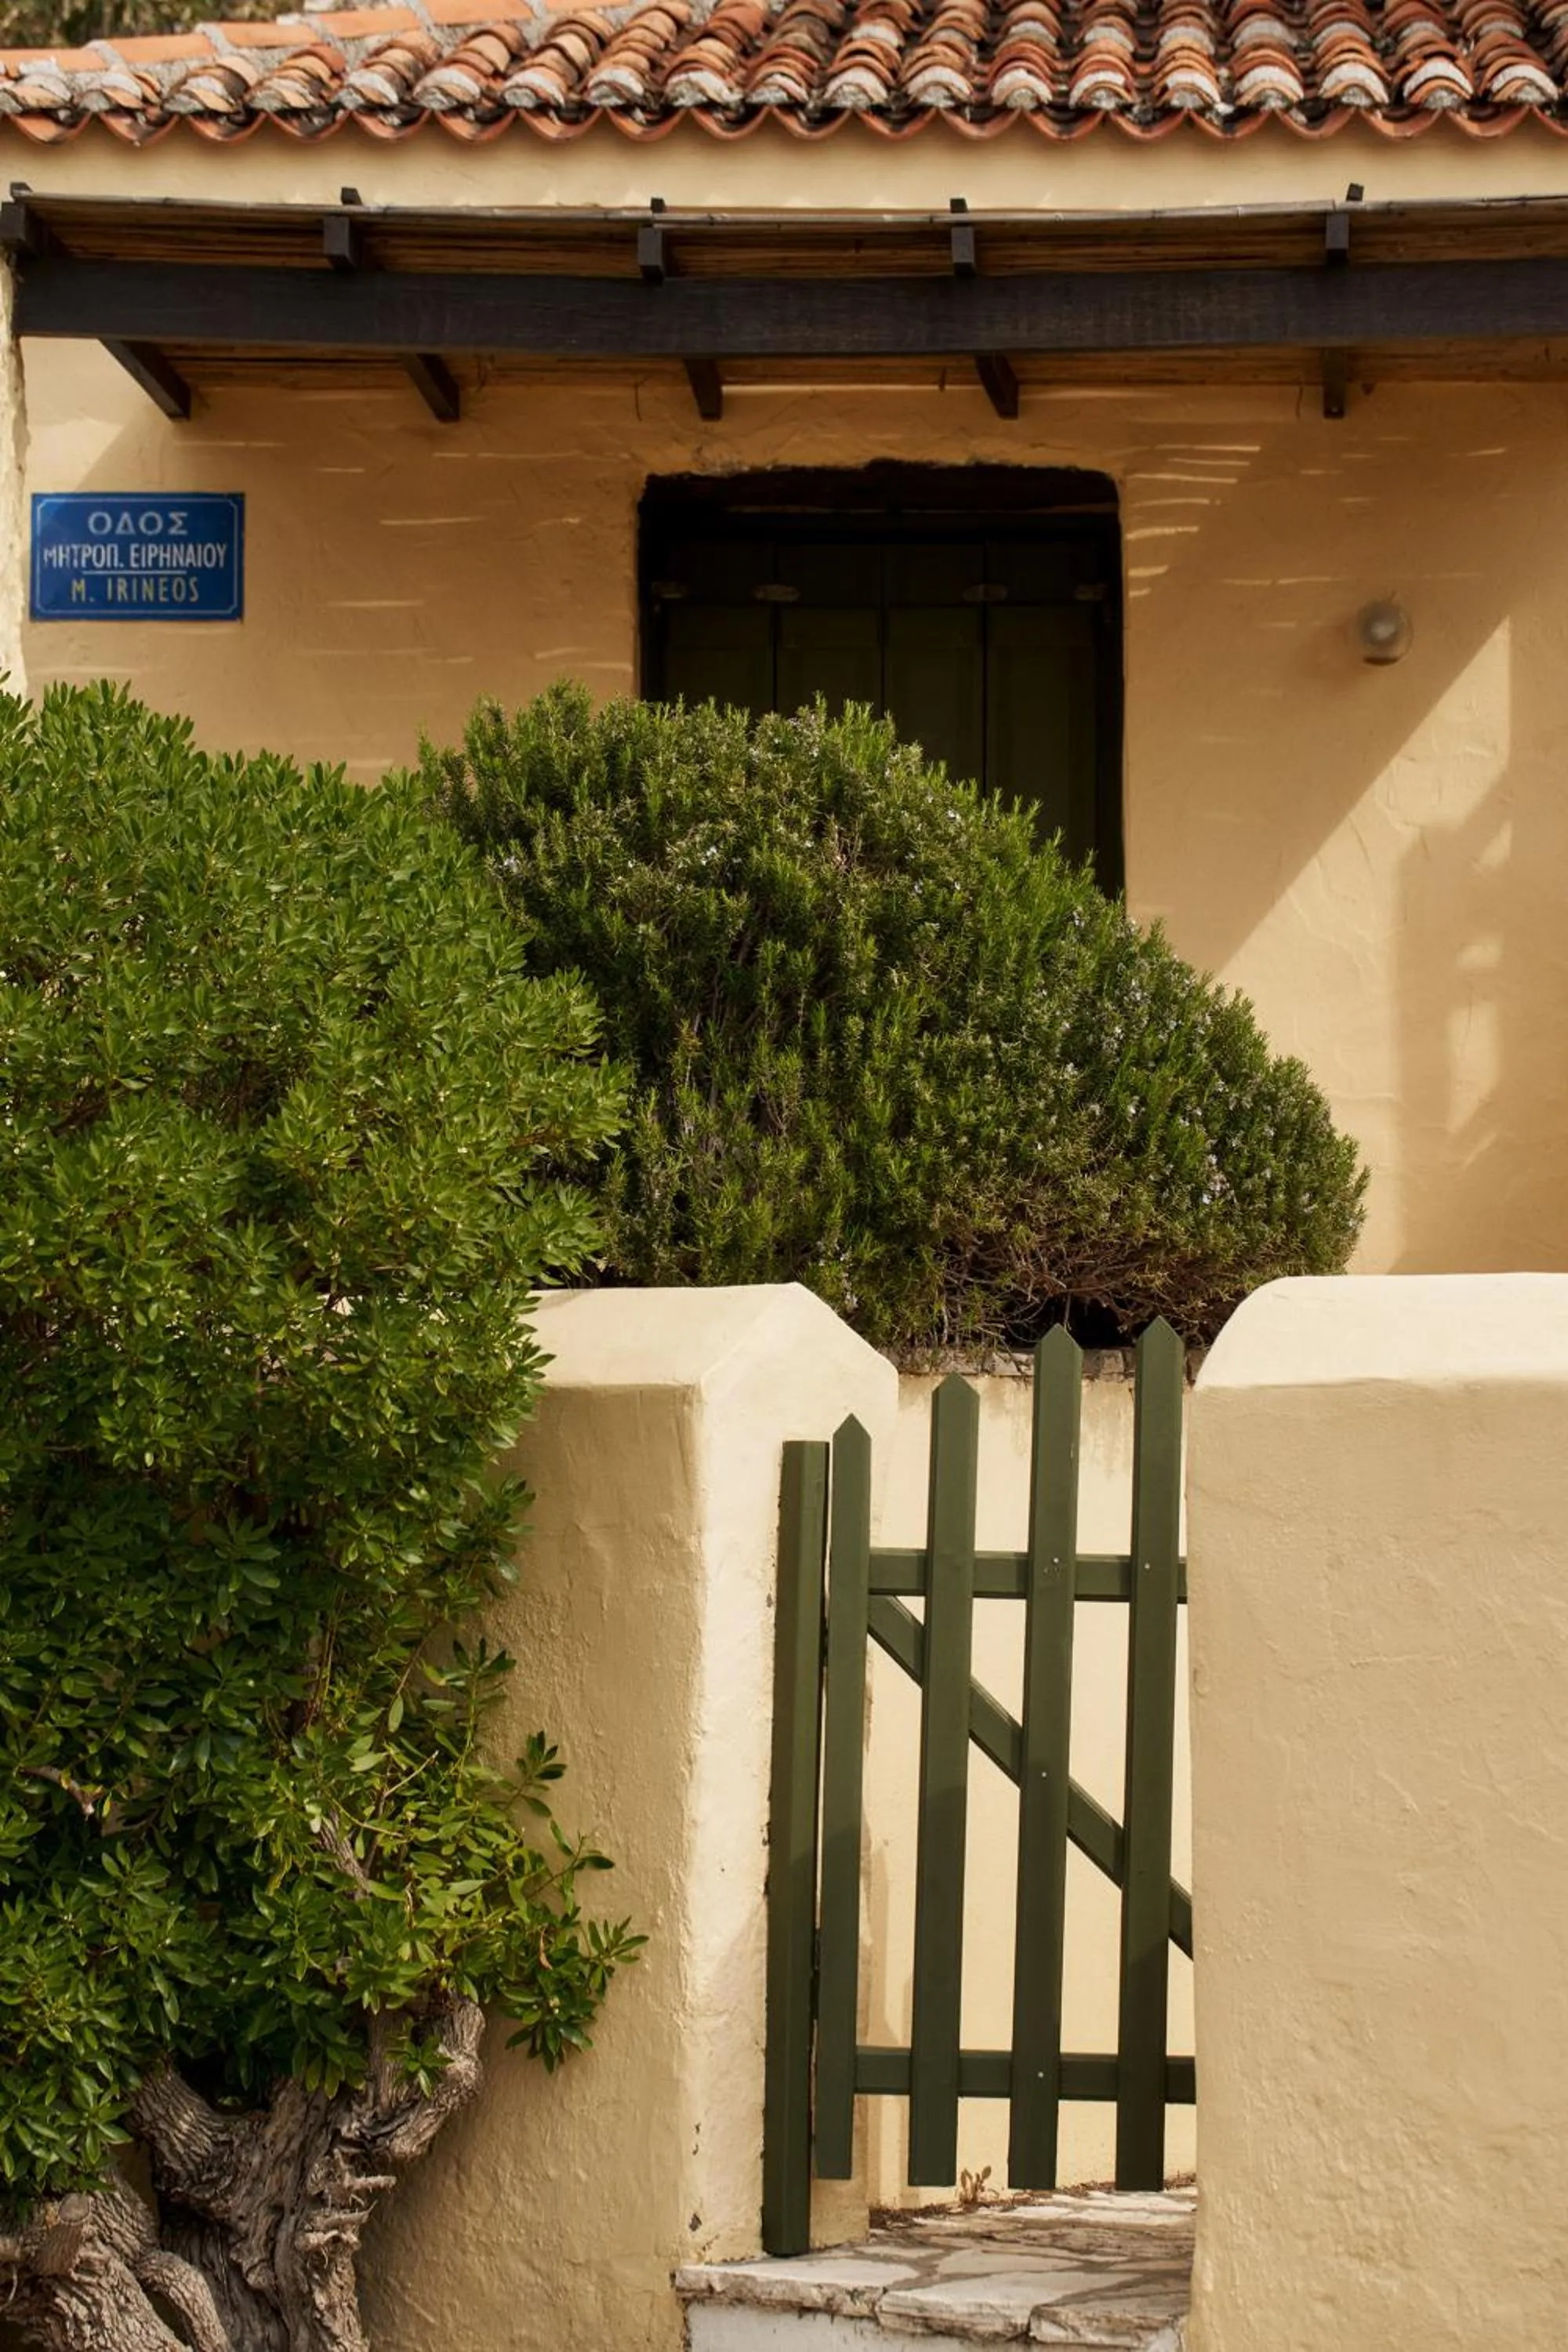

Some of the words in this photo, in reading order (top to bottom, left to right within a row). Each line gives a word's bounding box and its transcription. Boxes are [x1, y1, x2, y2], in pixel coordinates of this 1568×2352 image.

[88, 511, 188, 535] ΟΔΟΣ
[43, 543, 125, 568] ΜΗΤΡΟΠ.
[129, 542, 227, 568] ΕΙΡΗΝΑΙΟΥ
[71, 576, 95, 603] M.
[107, 576, 199, 603] IRINEOS
